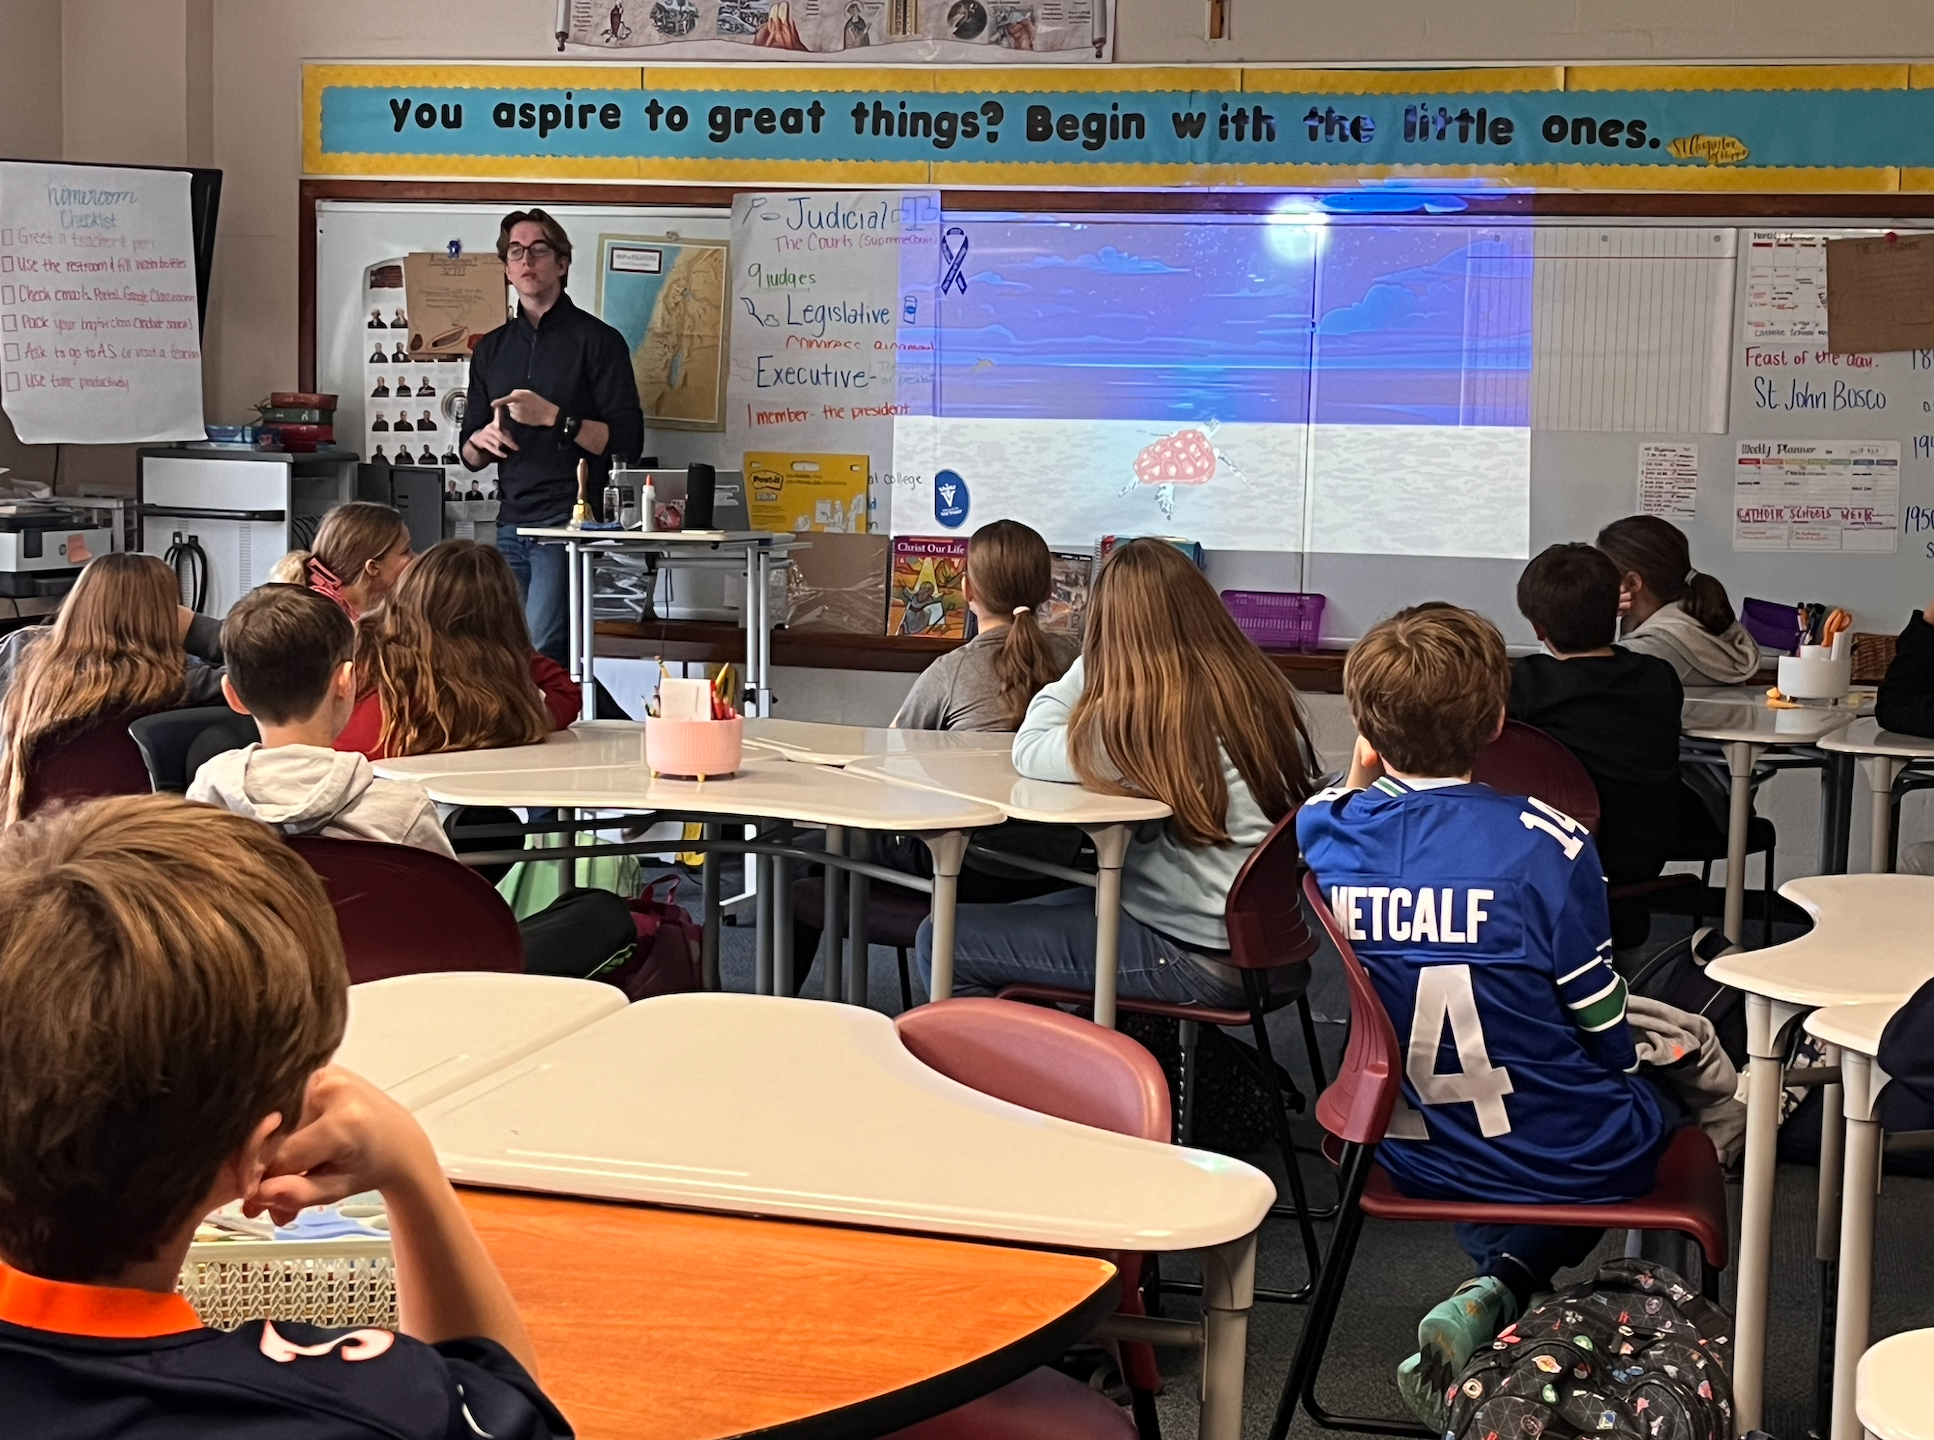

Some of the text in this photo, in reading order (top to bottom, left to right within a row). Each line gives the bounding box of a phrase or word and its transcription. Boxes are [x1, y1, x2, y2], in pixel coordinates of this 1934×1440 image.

[390, 92, 1661, 151] you aspire to great things? Begin with the little ones.
[786, 196, 888, 231] Judicial
[18, 227, 54, 246] Greet
[774, 235, 804, 252] The
[807, 232, 853, 251] Courts
[17, 256, 39, 273] Use
[42, 258, 61, 273] the
[66, 261, 108, 273] restroom
[19, 285, 52, 302] Check
[21, 314, 49, 329] Pack
[786, 293, 891, 338] Legislative
[24, 342, 48, 361] Ask
[54, 346, 66, 359] to
[68, 347, 82, 366] go
[84, 346, 97, 359] to
[1745, 345, 1788, 368] Feast
[1794, 350, 1809, 365] of
[1815, 351, 1839, 366] the
[25, 373, 46, 389] Use
[1784, 378, 1827, 411] John
[1832, 379, 1887, 412] Bosco
[822, 403, 845, 420] the
[851, 402, 911, 421] president
[1741, 443, 1771, 457] Weekly
[1777, 443, 1816, 455] Planner
[883, 471, 923, 491] college
[897, 542, 966, 555] Christ Our Life
[1519, 796, 1590, 860] 14
